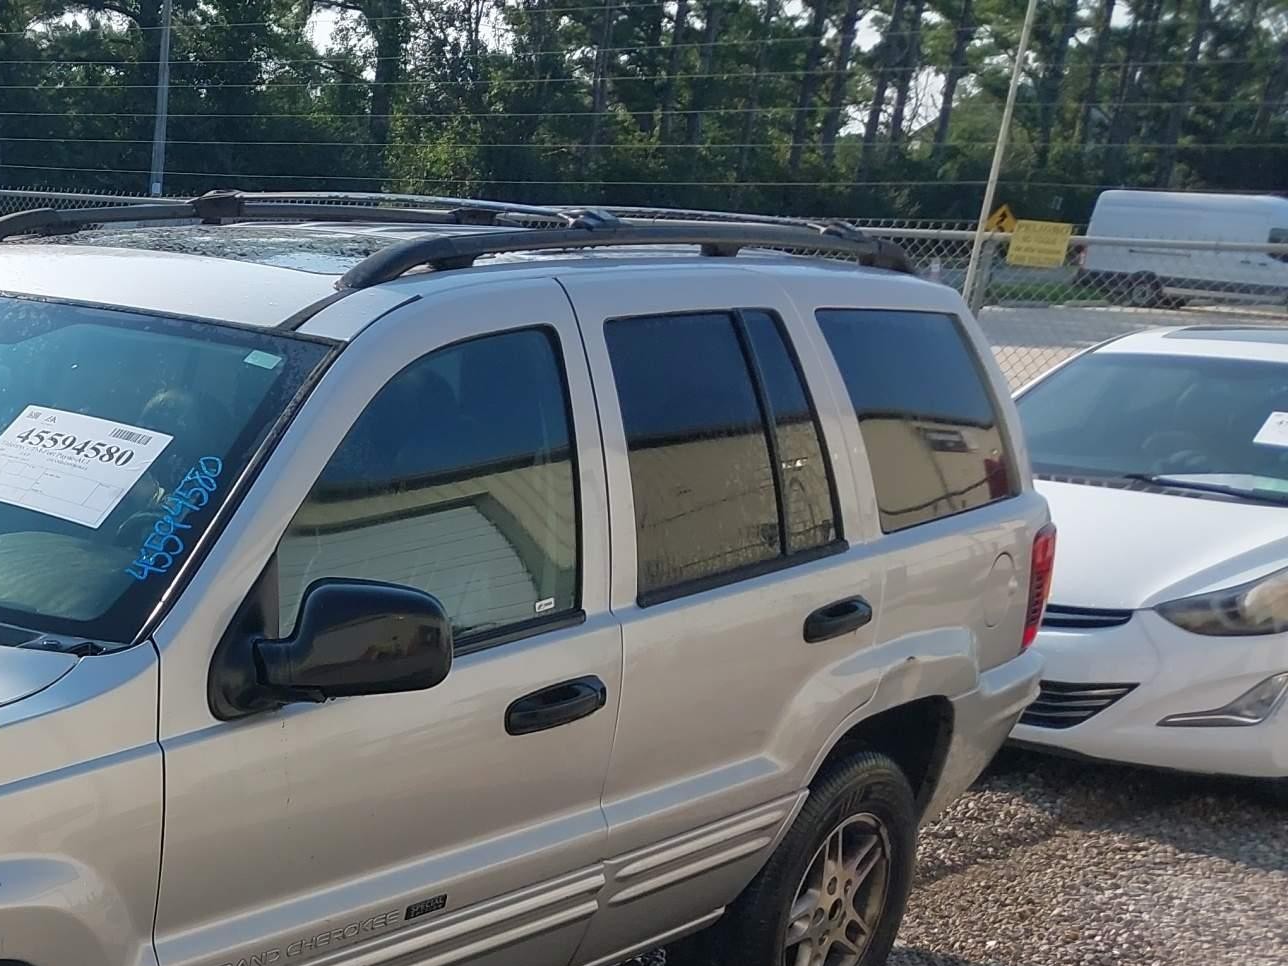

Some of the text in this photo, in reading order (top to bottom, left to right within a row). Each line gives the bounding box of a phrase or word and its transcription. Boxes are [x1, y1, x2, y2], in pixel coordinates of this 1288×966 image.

[16, 427, 135, 467] 45594580
[124, 456, 223, 580] 45594580
[285, 910, 401, 958] CHEROKEE
